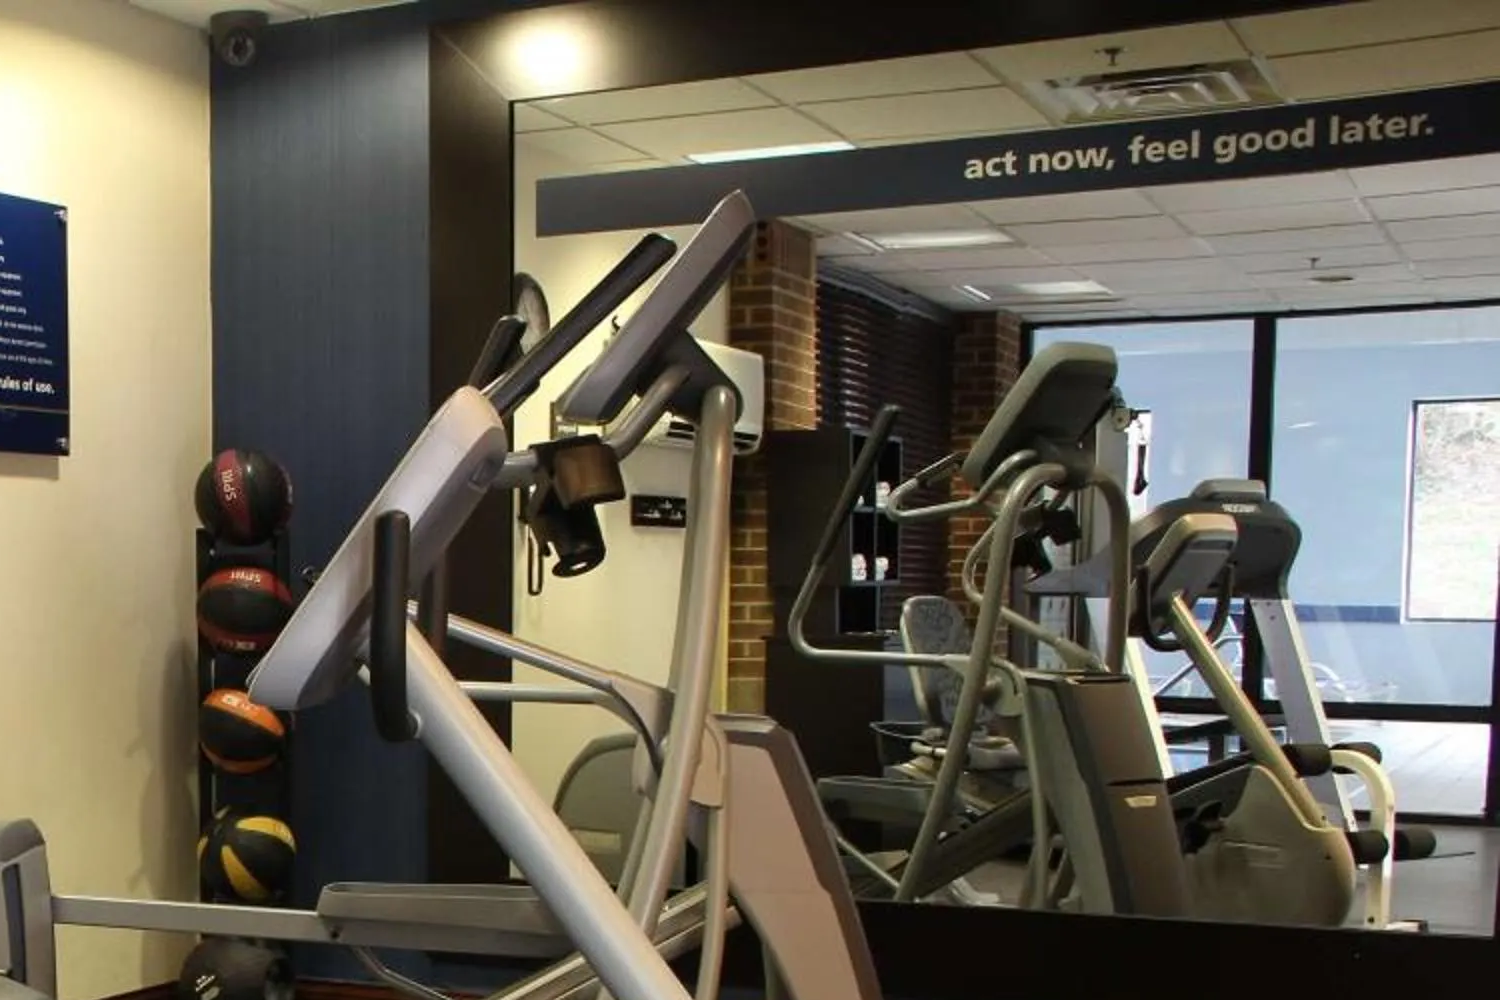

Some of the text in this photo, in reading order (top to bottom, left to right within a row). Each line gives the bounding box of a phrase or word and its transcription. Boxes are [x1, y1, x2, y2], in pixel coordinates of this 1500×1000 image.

[964, 110, 1435, 179] act now, feel good later.
[22, 378, 33, 392] of
